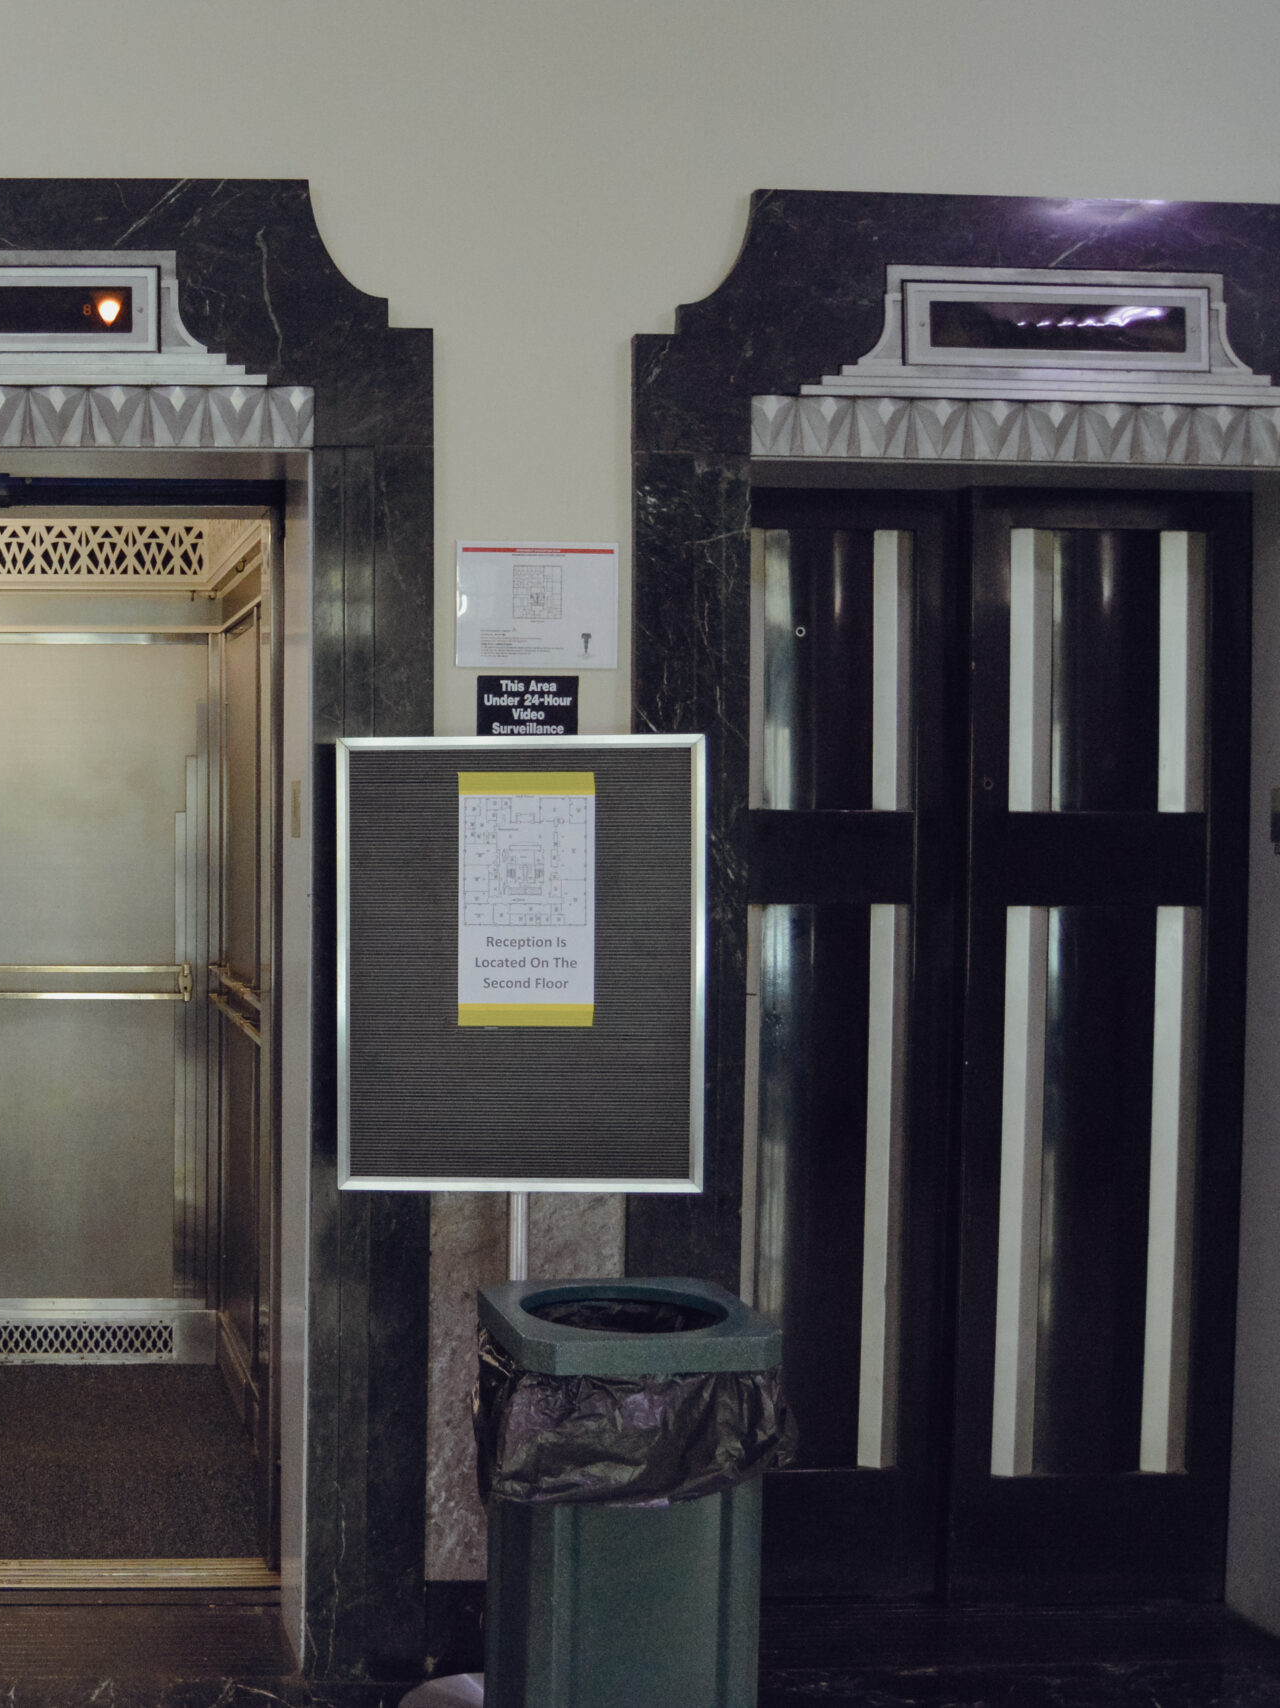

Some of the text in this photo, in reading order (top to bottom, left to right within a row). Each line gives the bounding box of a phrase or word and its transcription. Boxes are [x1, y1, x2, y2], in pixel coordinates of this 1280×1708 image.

[82, 303, 92, 316] 8
[500, 679, 557, 692] This Area
[484, 694, 572, 706] Under 24-Hour
[511, 708, 545, 720] Video
[491, 722, 564, 735] Surveillance
[486, 936, 567, 951] Reception Is
[475, 956, 578, 969] Located On The
[483, 976, 569, 989] Second Floor
